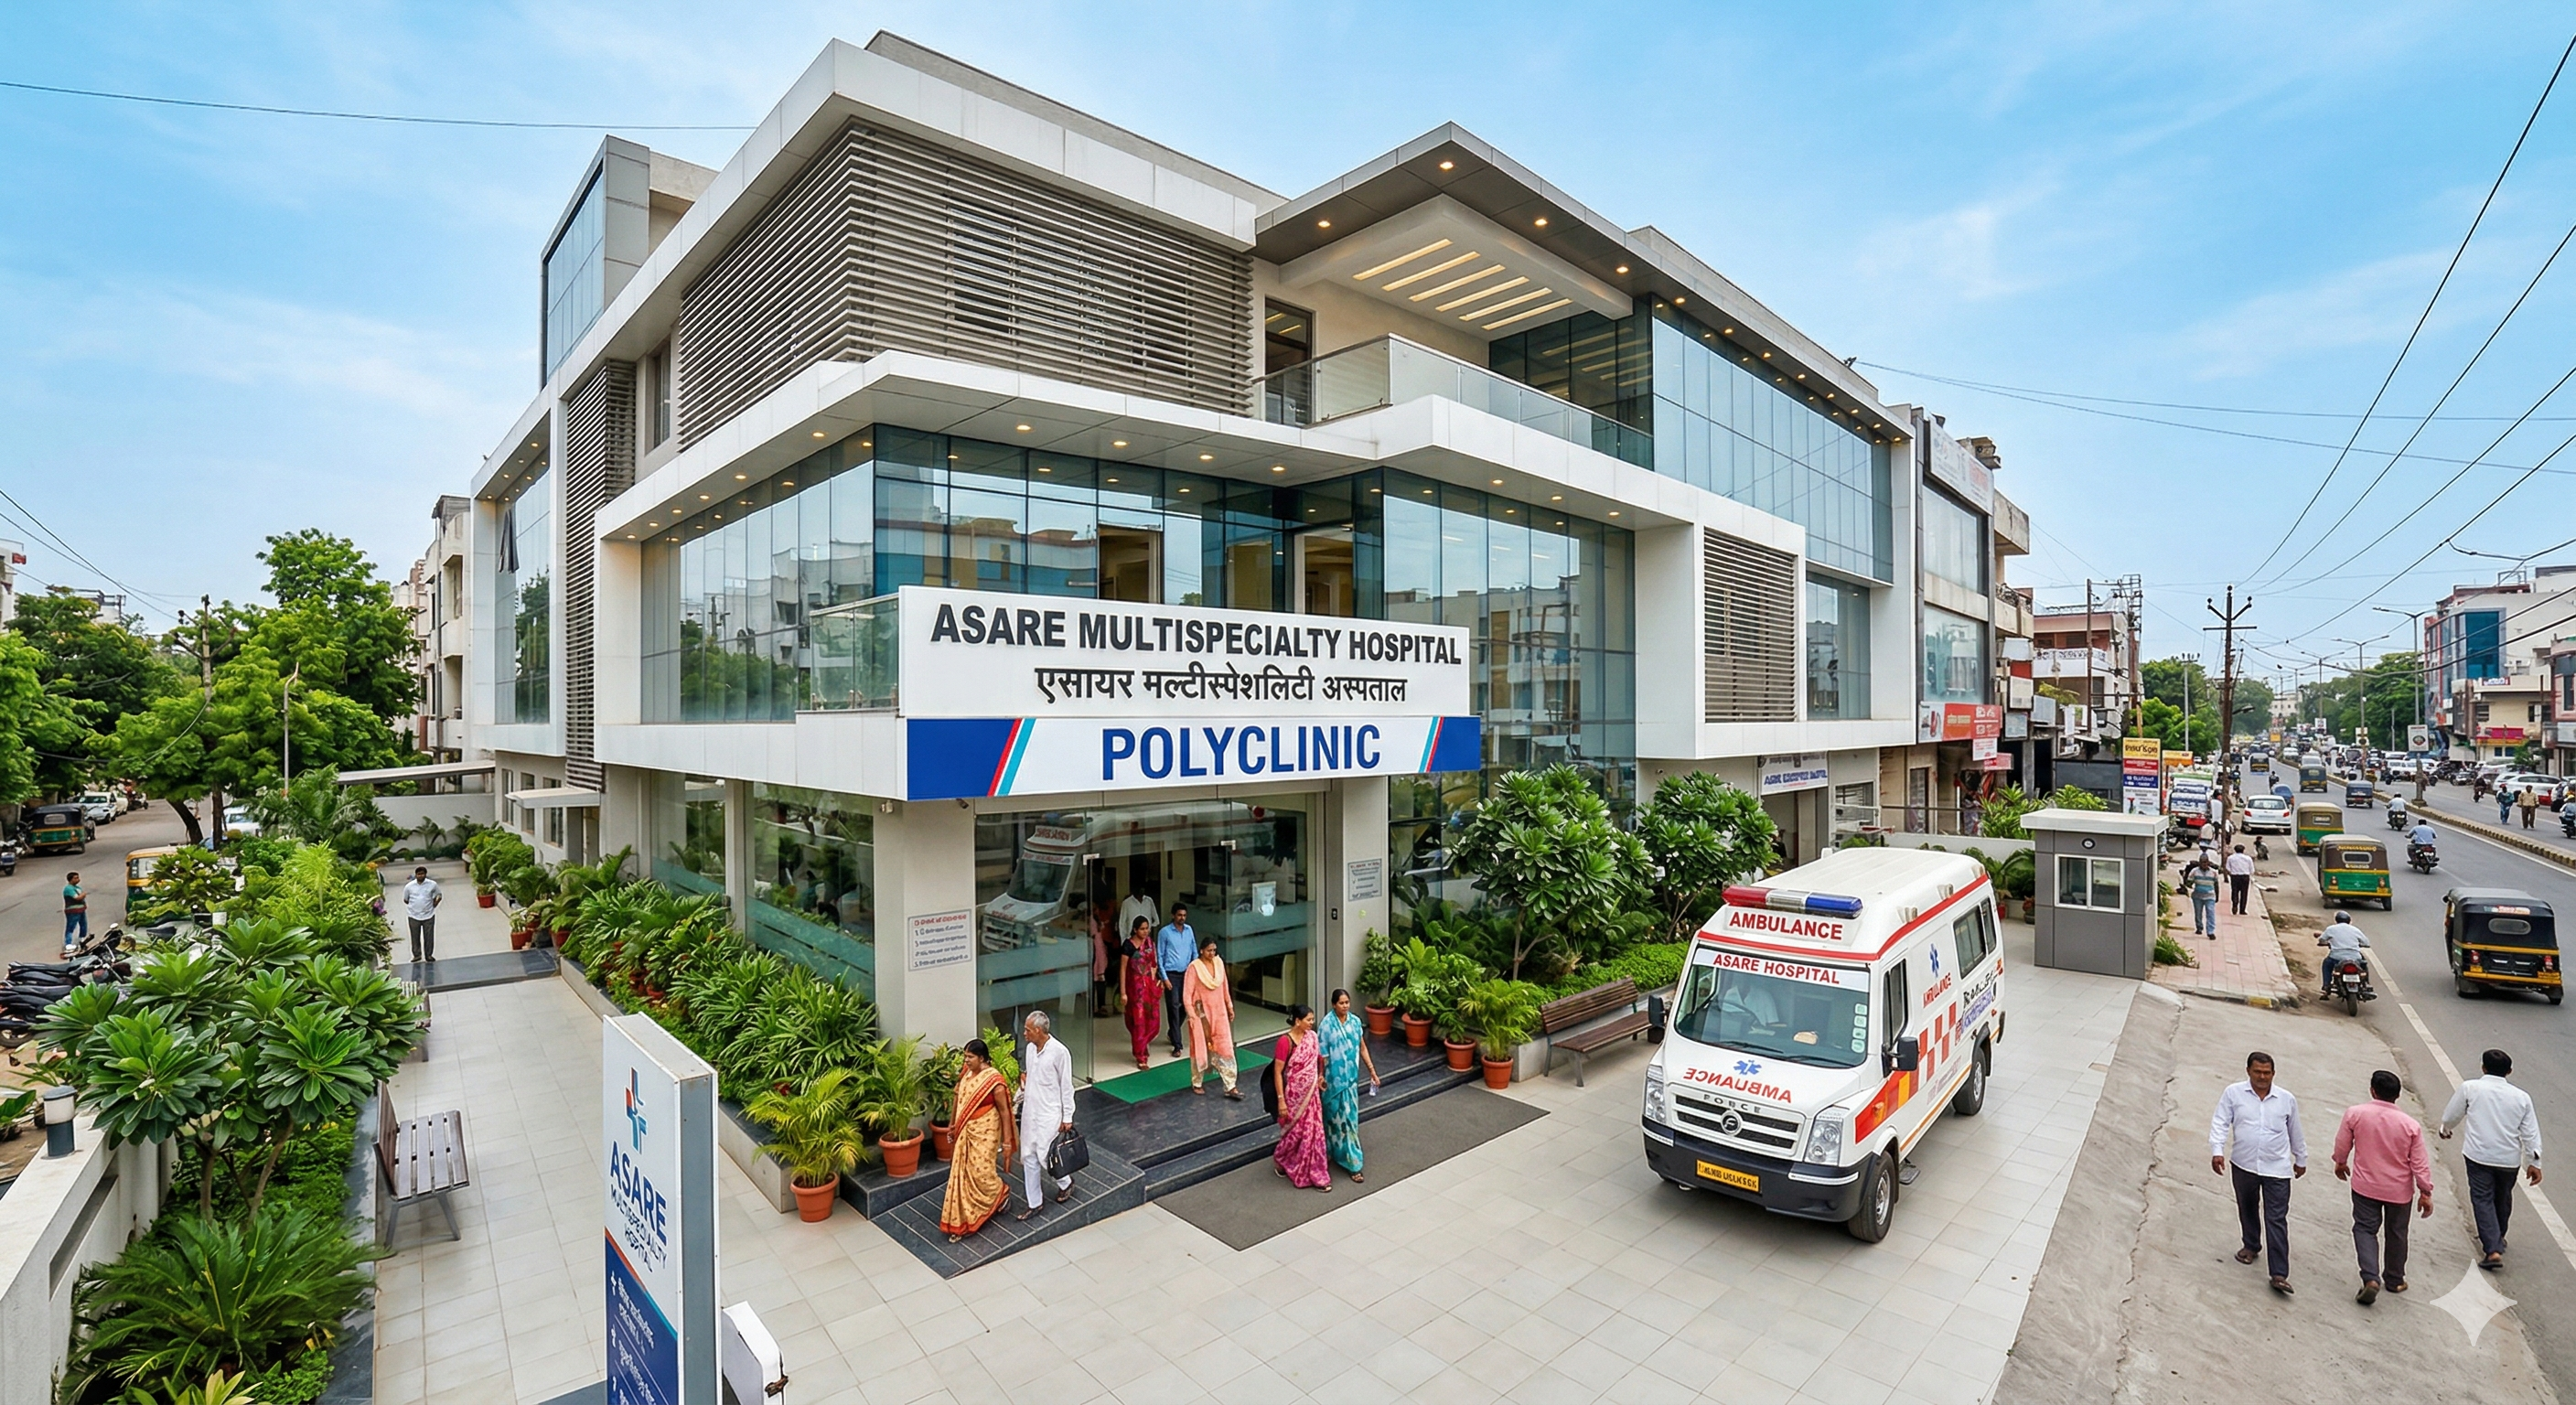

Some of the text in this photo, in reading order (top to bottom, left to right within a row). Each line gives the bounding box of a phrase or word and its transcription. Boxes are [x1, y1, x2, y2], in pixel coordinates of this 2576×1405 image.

[930, 605, 1463, 665] ASARE MULTISPECIALTY HOSPITAL
[1035, 661, 1408, 703] एसायर मल्टीस्पेशलिटी अस्पताल
[1102, 724, 1381, 781] POLYCLINIC
[1729, 912, 1842, 940] AMBULANCE
[1713, 954, 1840, 984] ASARE HOSPITAL
[1703, 1094, 1762, 1113] FORCE
[610, 1141, 667, 1247] ASARE
